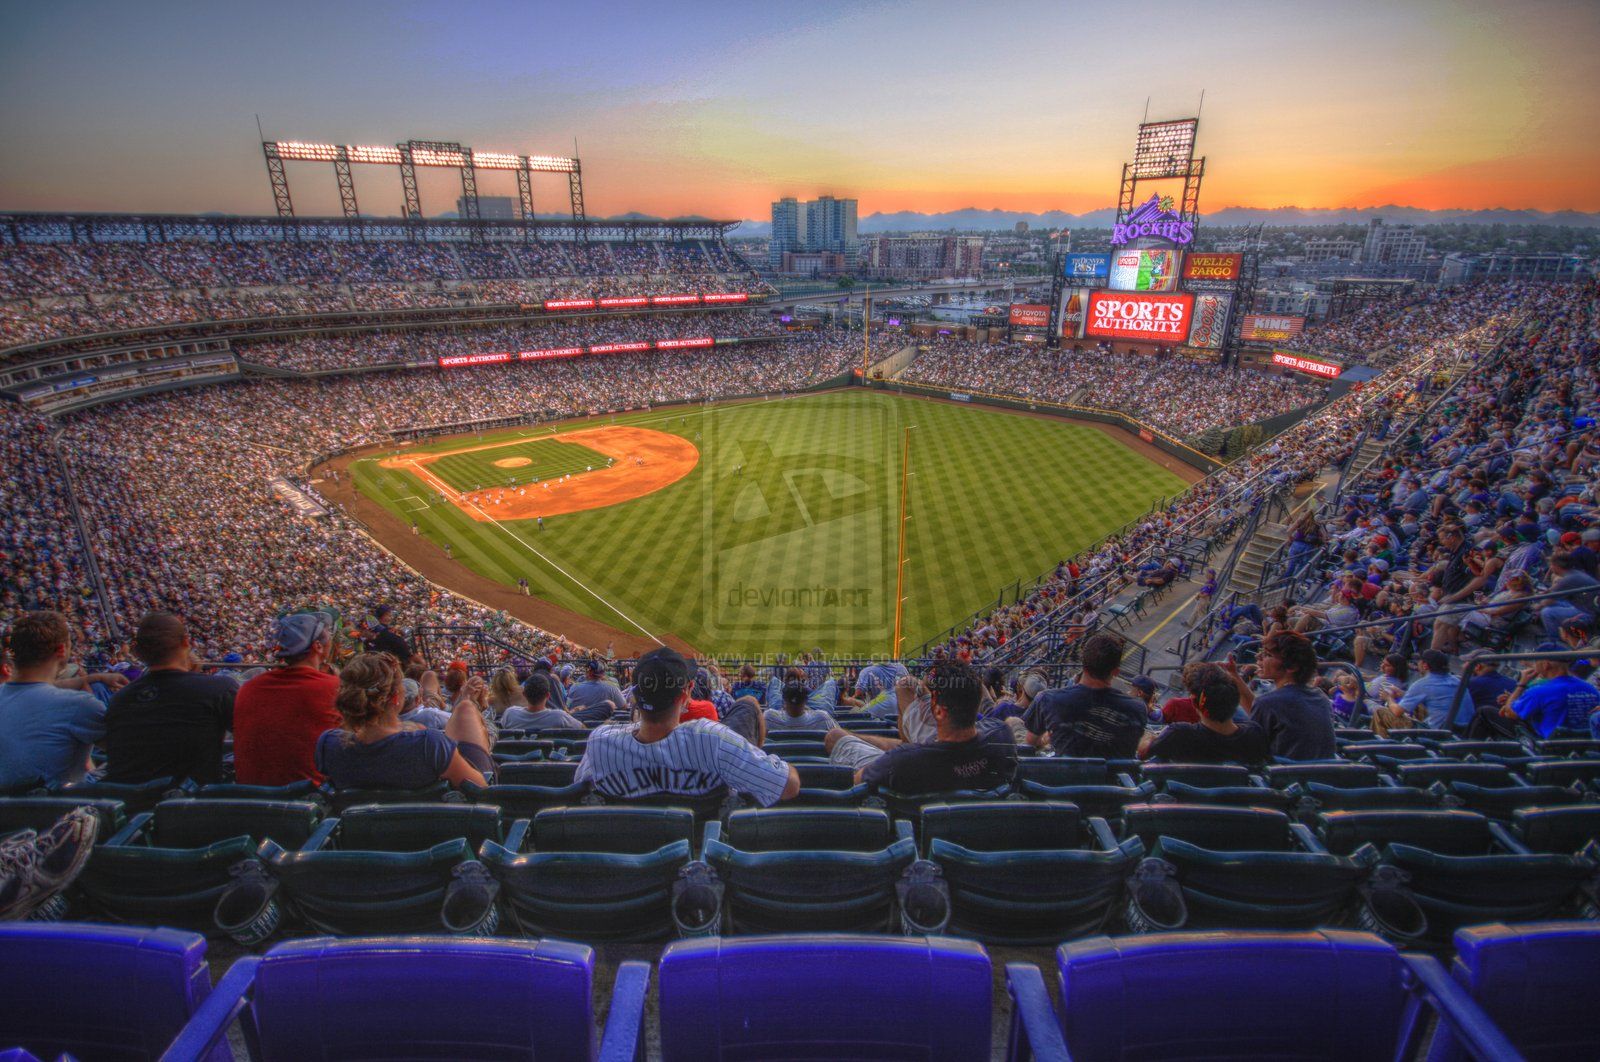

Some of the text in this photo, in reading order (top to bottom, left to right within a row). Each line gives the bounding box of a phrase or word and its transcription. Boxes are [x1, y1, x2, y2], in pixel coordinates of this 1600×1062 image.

[1110, 221, 1194, 244] ROCKIES
[1192, 257, 1233, 267] WELLS
[1191, 267, 1231, 276] FARGO
[1095, 300, 1184, 321] SPORTS
[1093, 318, 1181, 333] AUTHORITY
[613, 342, 647, 350] AUTHORITY
[679, 338, 711, 346] AUTHORITY
[545, 348, 580, 356] AUTHORITY
[442, 357, 467, 365] SPORTS
[469, 354, 508, 362] AUTHORITY
[1275, 354, 1337, 375] SPORTS AUTHORITY
